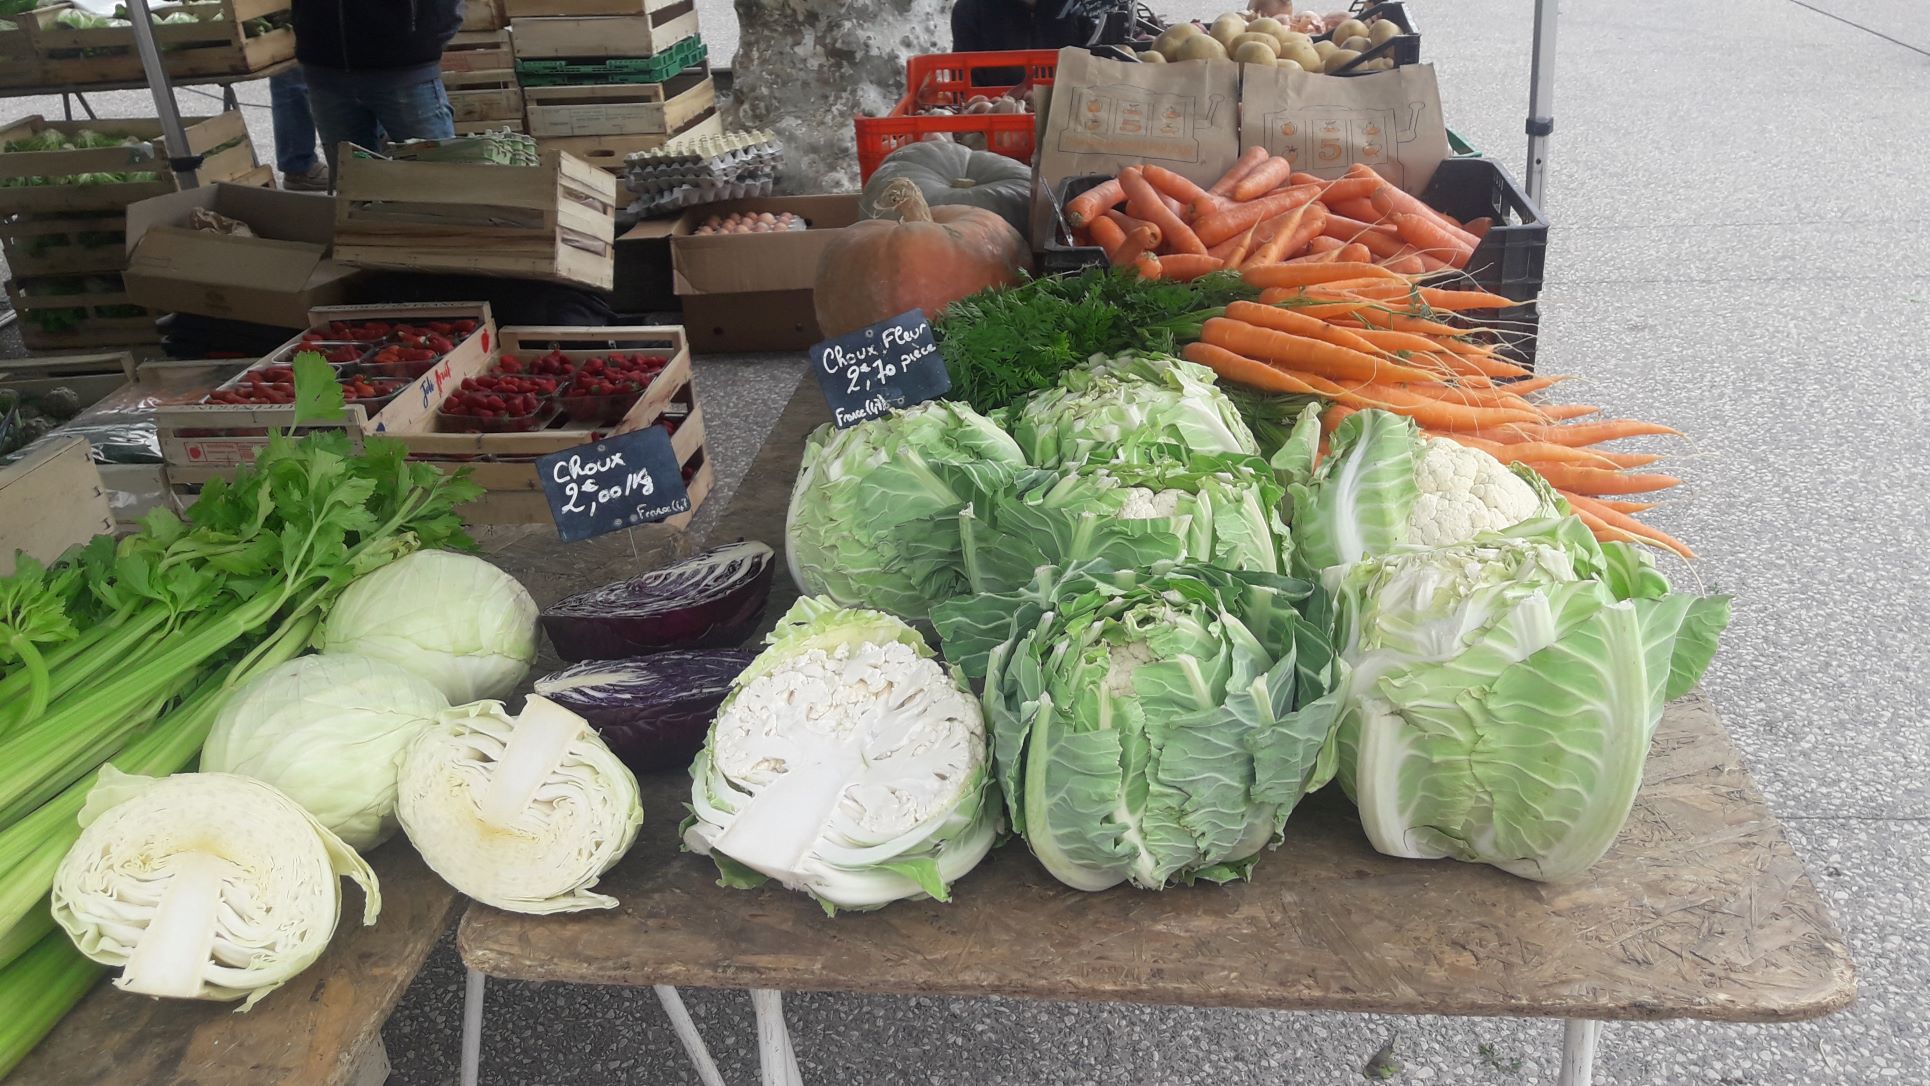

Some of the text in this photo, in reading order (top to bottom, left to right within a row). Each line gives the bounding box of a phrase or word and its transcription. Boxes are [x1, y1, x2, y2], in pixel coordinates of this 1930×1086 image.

[1318, 138, 1342, 161] 5
[823, 322, 927, 374] Choux Fleur
[553, 452, 627, 483] Choux
